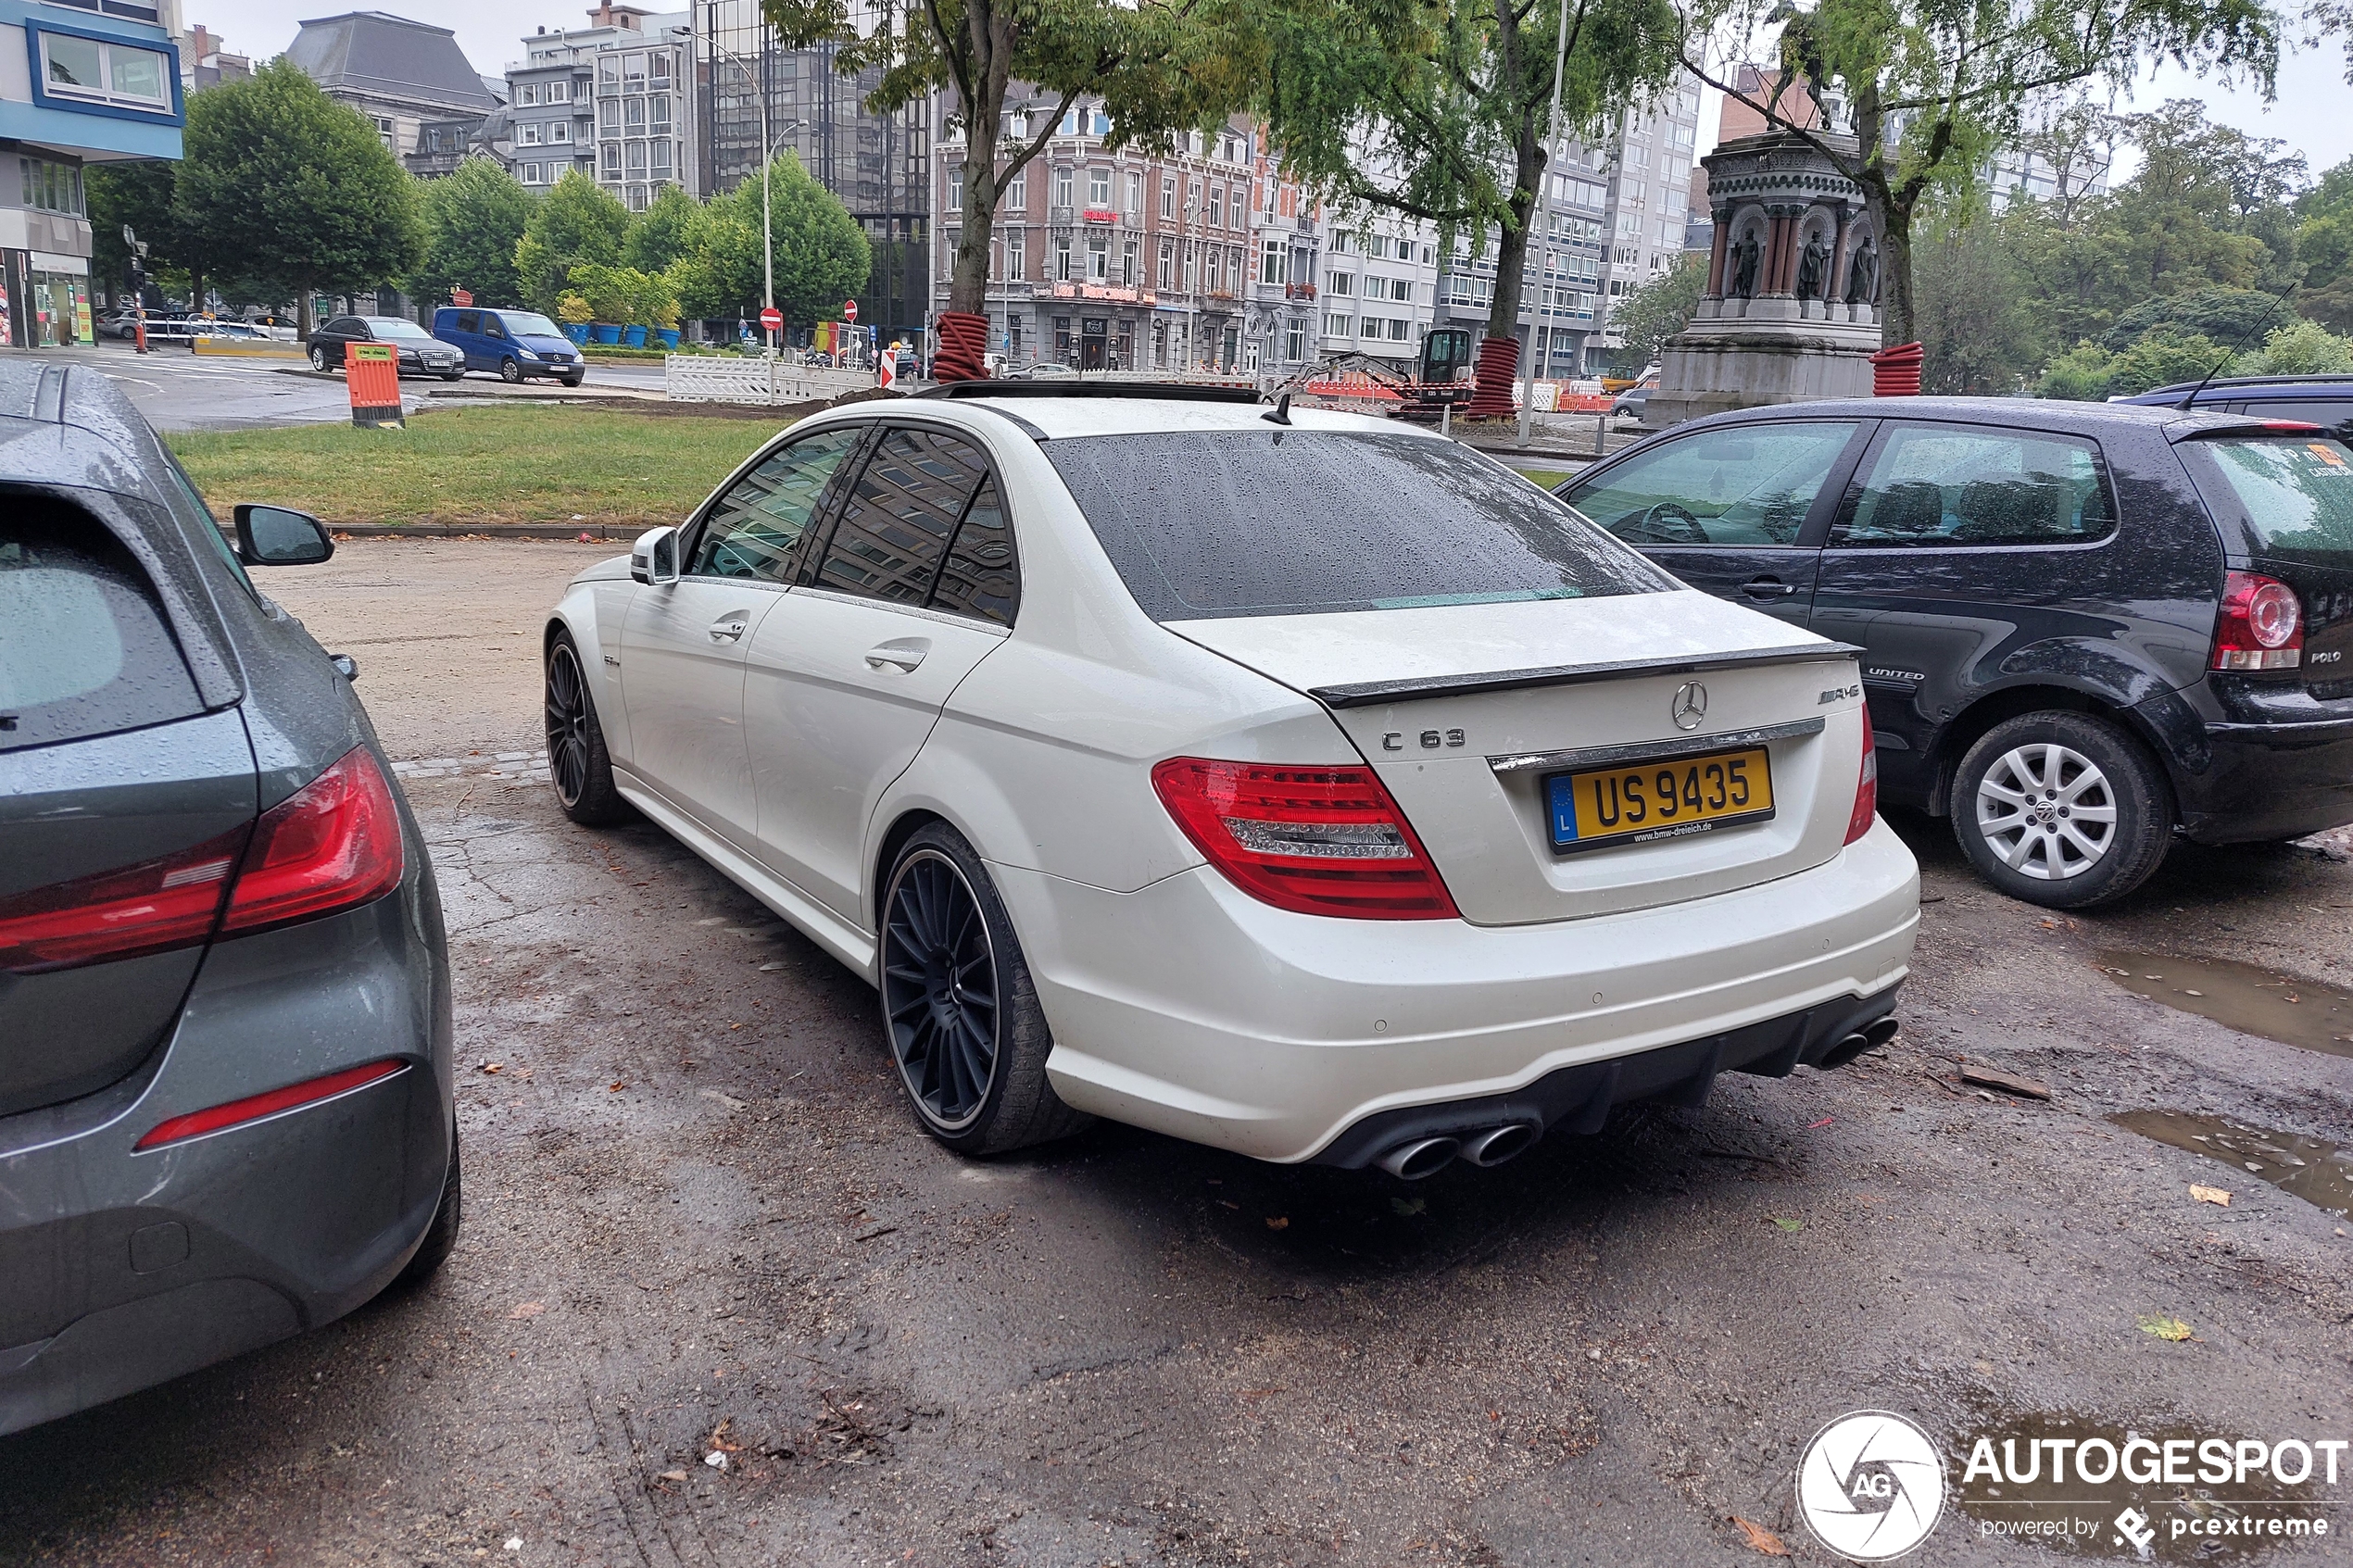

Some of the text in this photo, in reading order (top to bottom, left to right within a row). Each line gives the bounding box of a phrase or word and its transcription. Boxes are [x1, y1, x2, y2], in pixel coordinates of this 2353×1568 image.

[1084, 210, 1118, 221] PRIMUS
[1053, 282, 1075, 296] Les
[1079, 283, 1138, 301] Terrasses
[2311, 651, 2341, 664] POLO
[1869, 667, 1925, 681] UNITED
[1382, 728, 1466, 750] C 63
[1594, 759, 1750, 827] US 9435
[1559, 814, 1570, 831] L
[1634, 822, 1712, 843] www.bmw-dreieich.de
